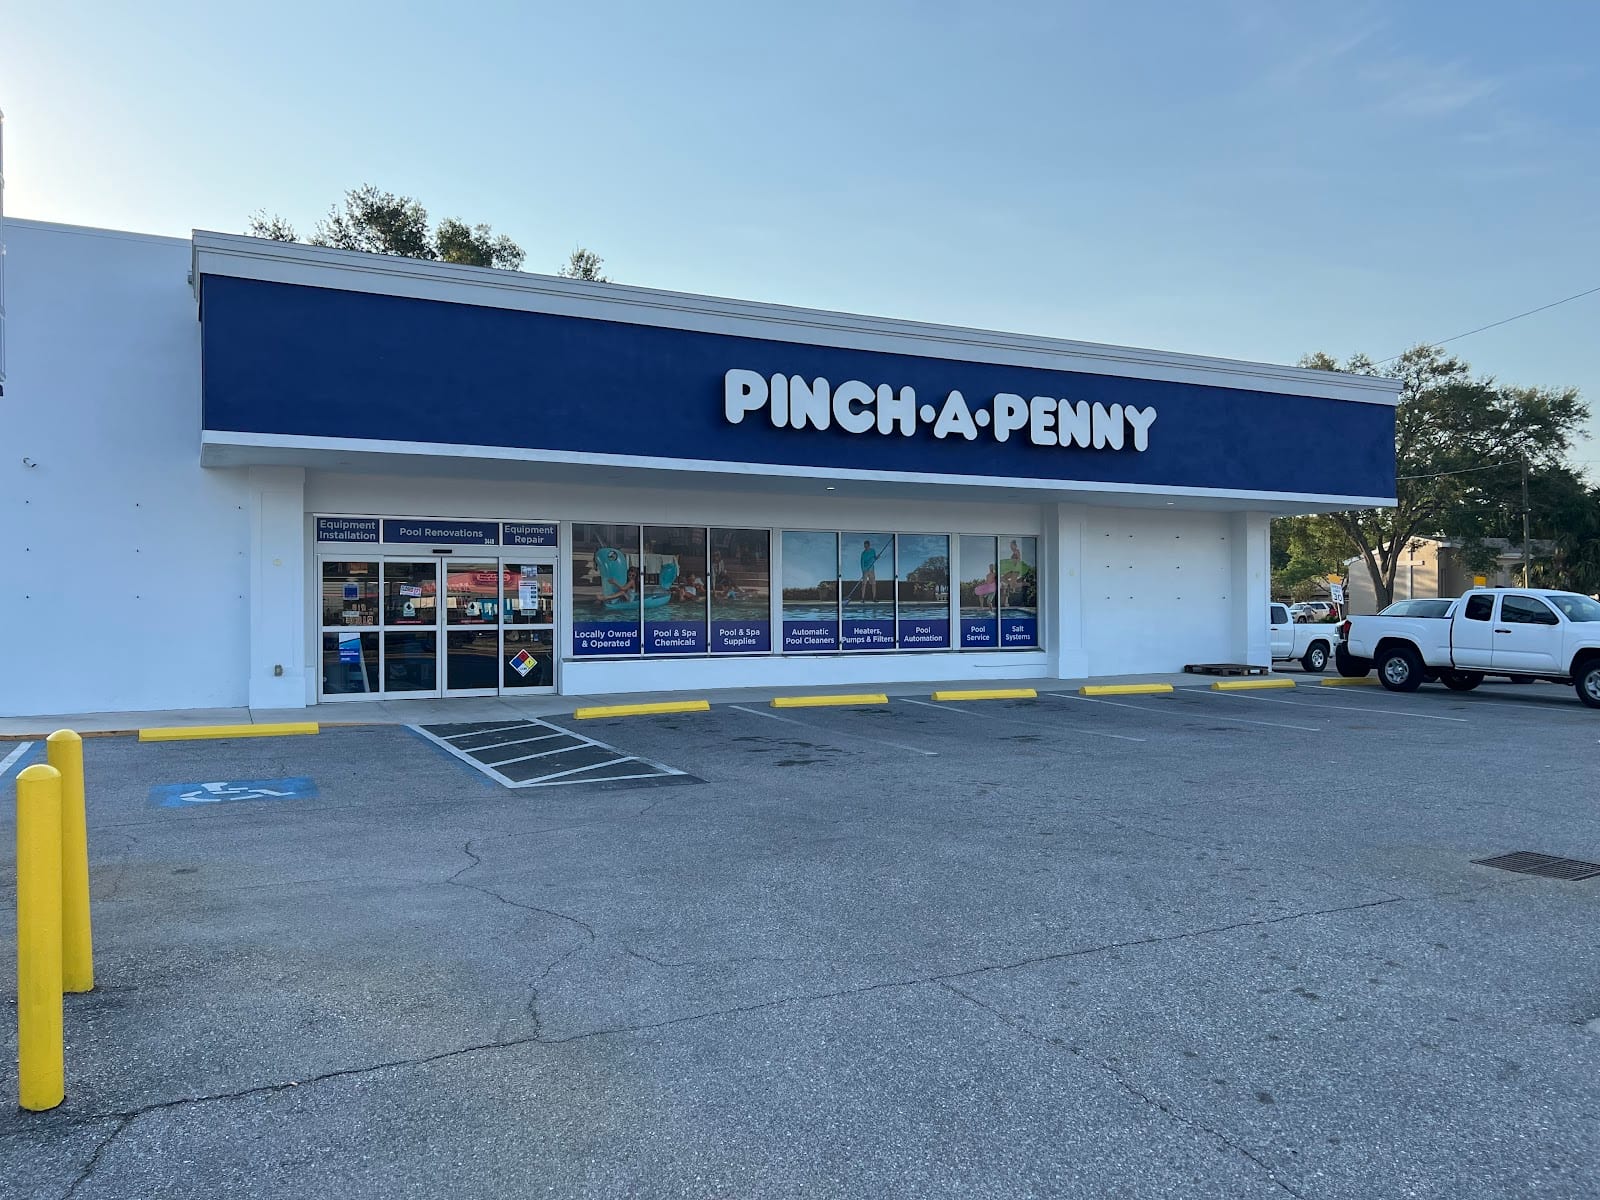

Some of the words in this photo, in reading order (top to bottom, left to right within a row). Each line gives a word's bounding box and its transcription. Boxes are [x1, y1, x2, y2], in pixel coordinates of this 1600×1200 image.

[320, 520, 375, 530] Equipment
[400, 527, 422, 536] Pool
[424, 528, 484, 538] Renovations
[504, 525, 554, 535] Equipment
[320, 530, 376, 540] Installation
[514, 535, 544, 544] Repair
[653, 629, 672, 637] Pool
[674, 629, 680, 637] &
[681, 629, 697, 638] Spa
[719, 628, 737, 636] Pool
[738, 628, 745, 636] &
[746, 628, 761, 637] Spa
[791, 628, 829, 636] Automatic
[915, 626, 931, 634] Pool
[970, 625, 986, 633] Pool
[574, 630, 605, 639] Locally
[607, 630, 637, 638] Owned
[590, 640, 631, 649] Operated
[654, 638, 696, 647] Chemicals
[723, 637, 757, 646] Supplies
[841, 636, 865, 644] Pumps
